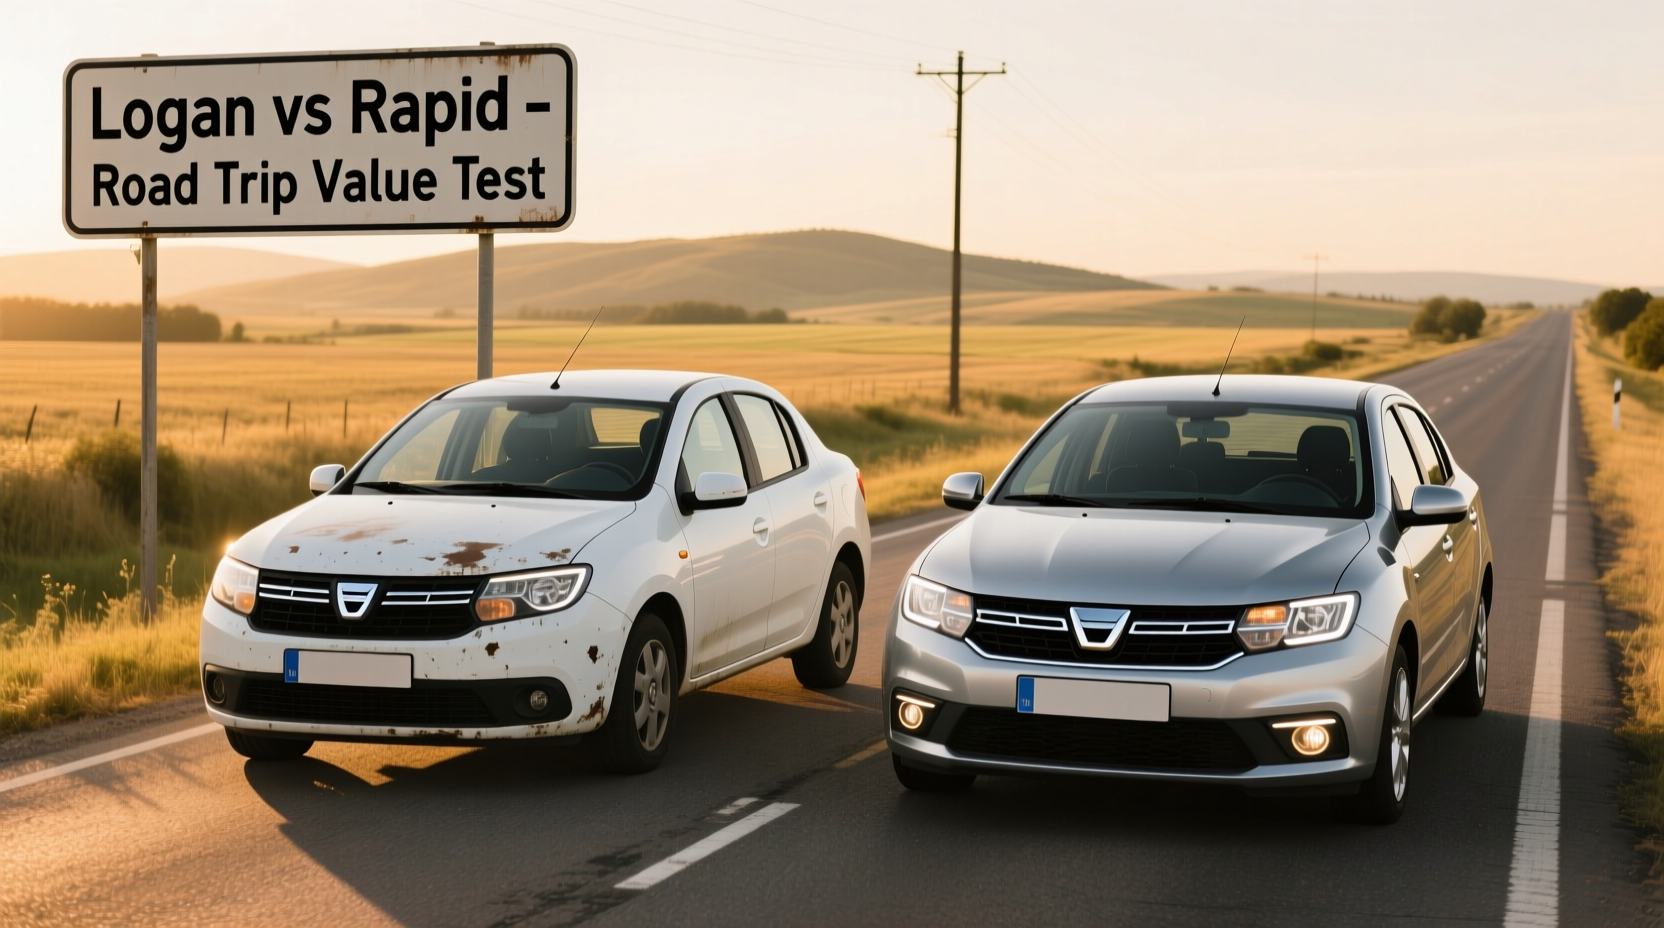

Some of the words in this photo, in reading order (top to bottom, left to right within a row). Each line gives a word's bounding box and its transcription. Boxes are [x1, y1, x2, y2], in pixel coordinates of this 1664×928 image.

[92, 86, 255, 154] Logan
[272, 94, 332, 136] vs
[351, 75, 509, 148] Rapid
[93, 161, 199, 207] Road
[213, 160, 298, 216] Trip
[312, 157, 438, 203] Value
[452, 155, 546, 201] Test
